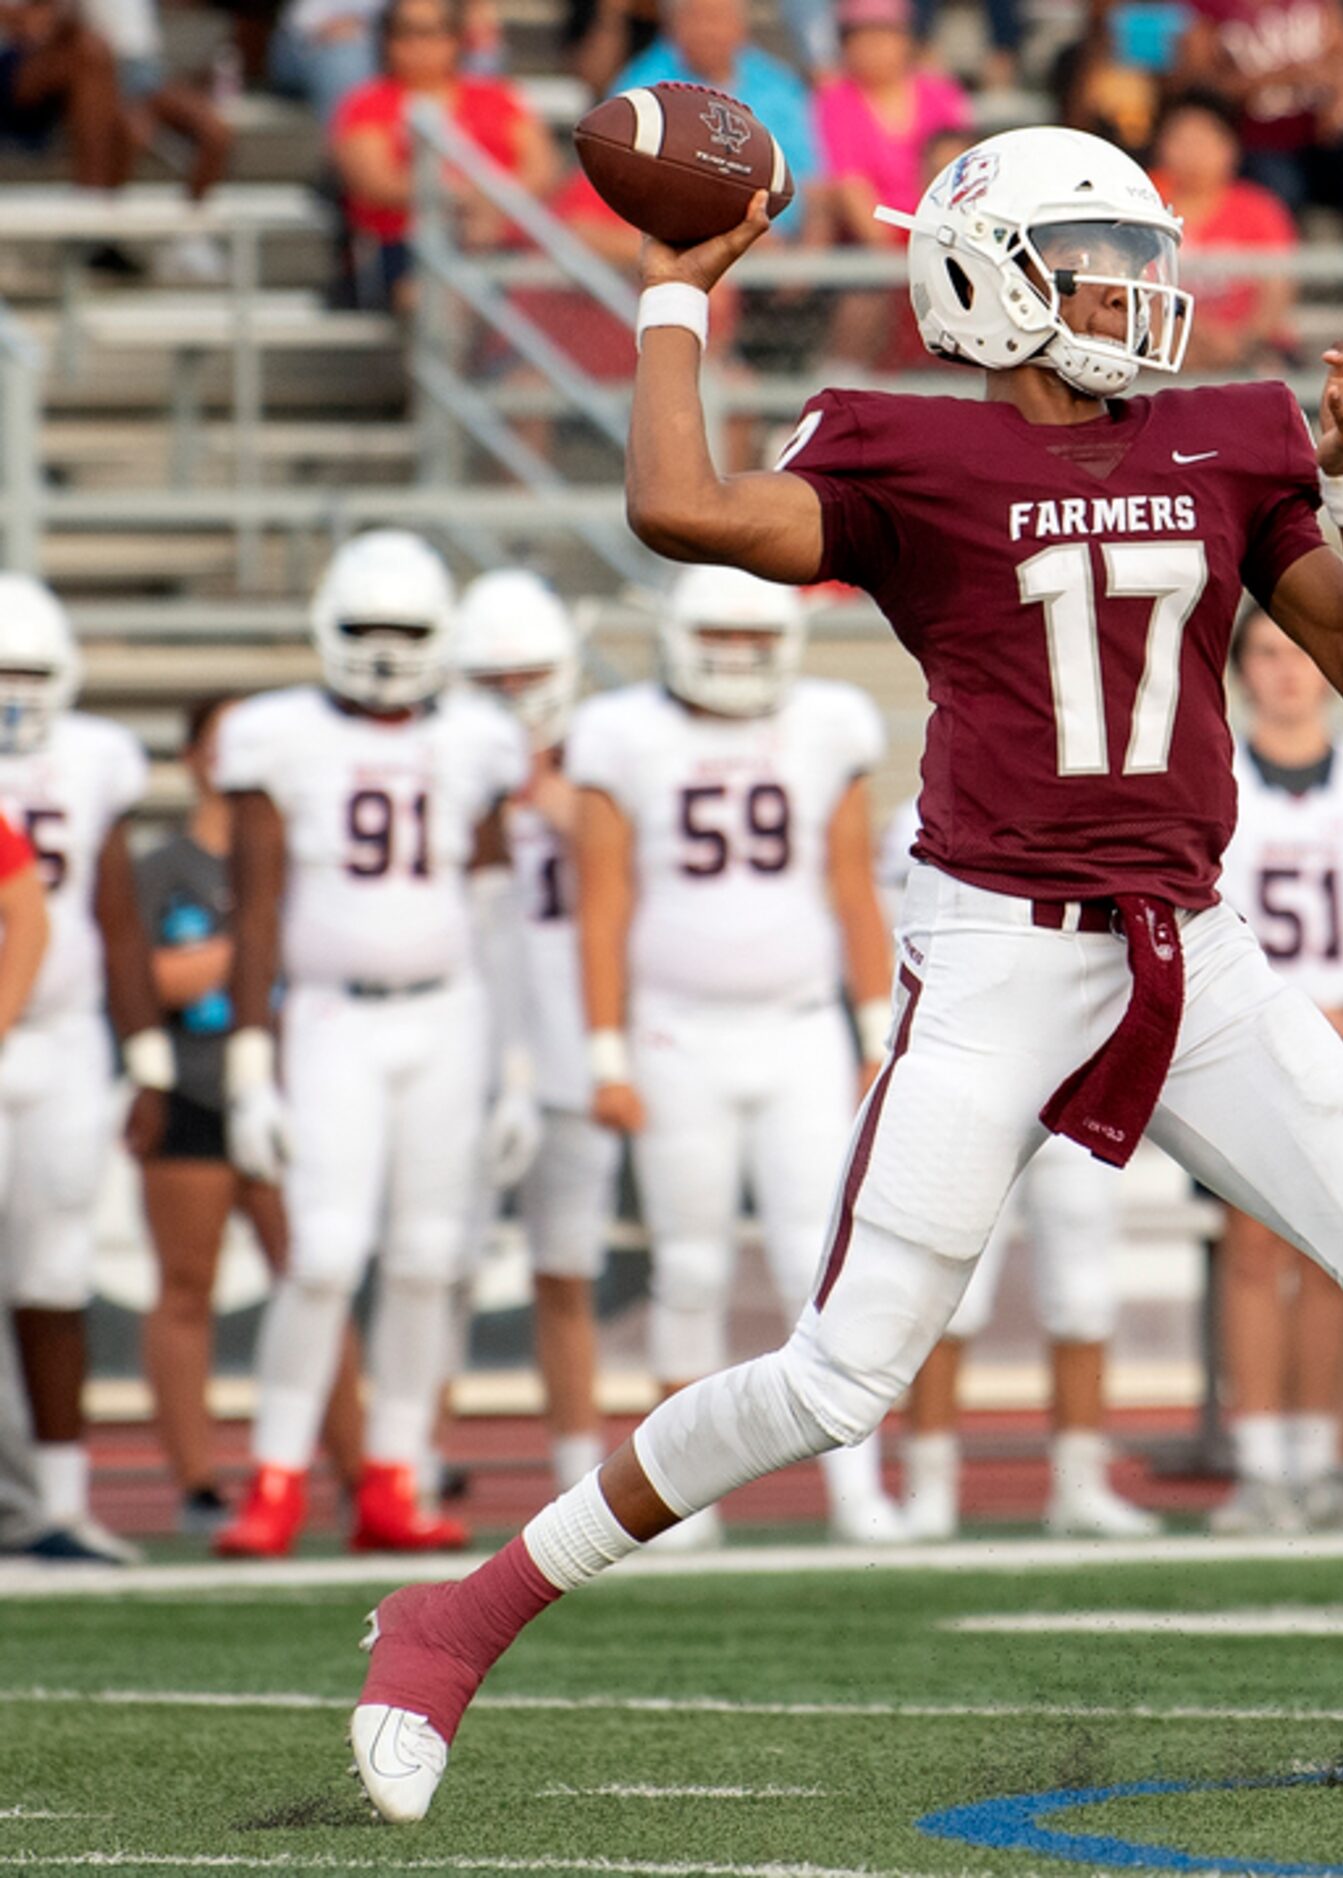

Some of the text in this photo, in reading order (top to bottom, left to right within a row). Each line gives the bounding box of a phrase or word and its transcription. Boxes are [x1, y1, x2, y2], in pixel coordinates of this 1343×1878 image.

[1009, 495, 1196, 541] FARMERS
[1015, 539, 1208, 777] 17
[345, 788, 429, 880] 91
[680, 783, 789, 878] 59
[1259, 868, 1341, 962] 51
